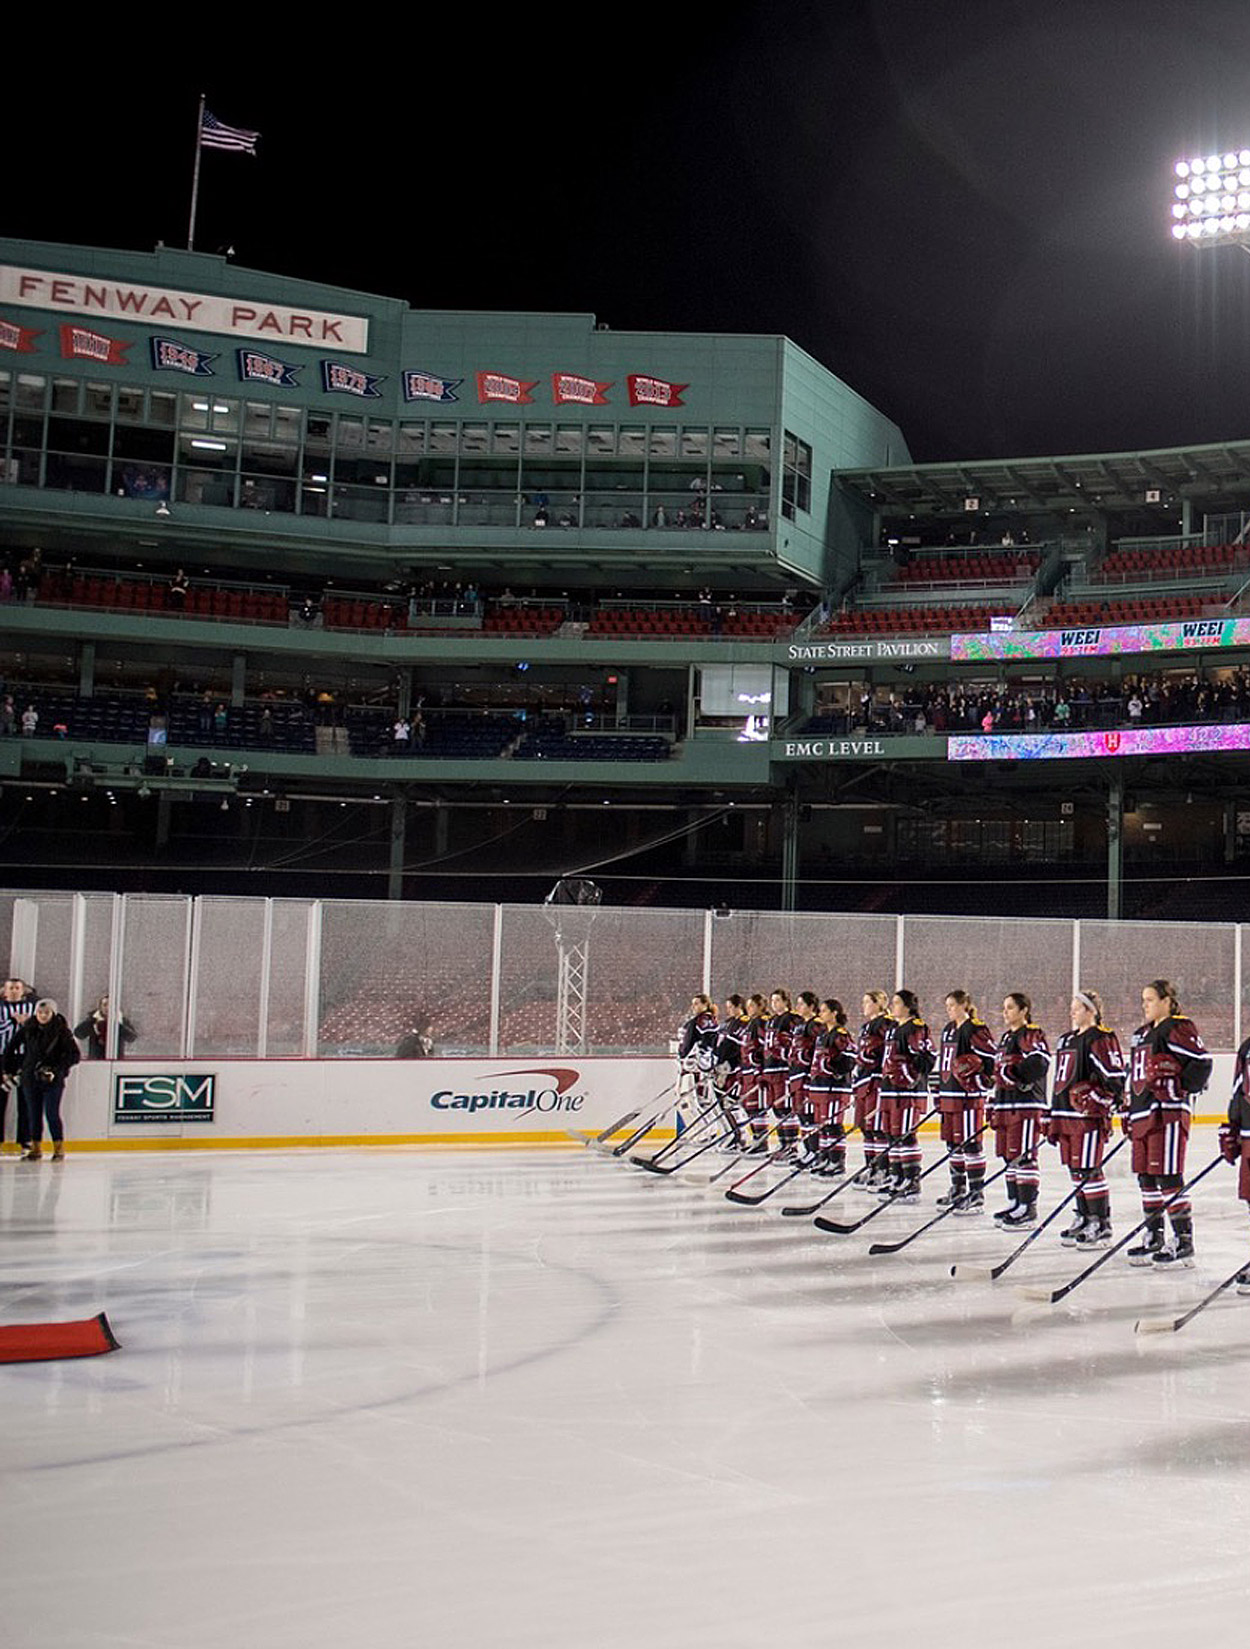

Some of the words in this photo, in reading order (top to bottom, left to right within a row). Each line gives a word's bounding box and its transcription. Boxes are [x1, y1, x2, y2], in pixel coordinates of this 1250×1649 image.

[19, 274, 203, 321] FENWAY
[231, 306, 343, 343] PARK
[1182, 621, 1224, 637] WEEI
[1060, 630, 1100, 646] WEEI
[788, 645, 826, 659] STATE
[827, 644, 872, 658] STREET
[876, 642, 938, 656] PAVILION
[786, 742, 823, 756] EMC
[829, 741, 885, 755] LEVEL
[1133, 1050, 1145, 1080] H
[118, 1076, 212, 1109] FSM
